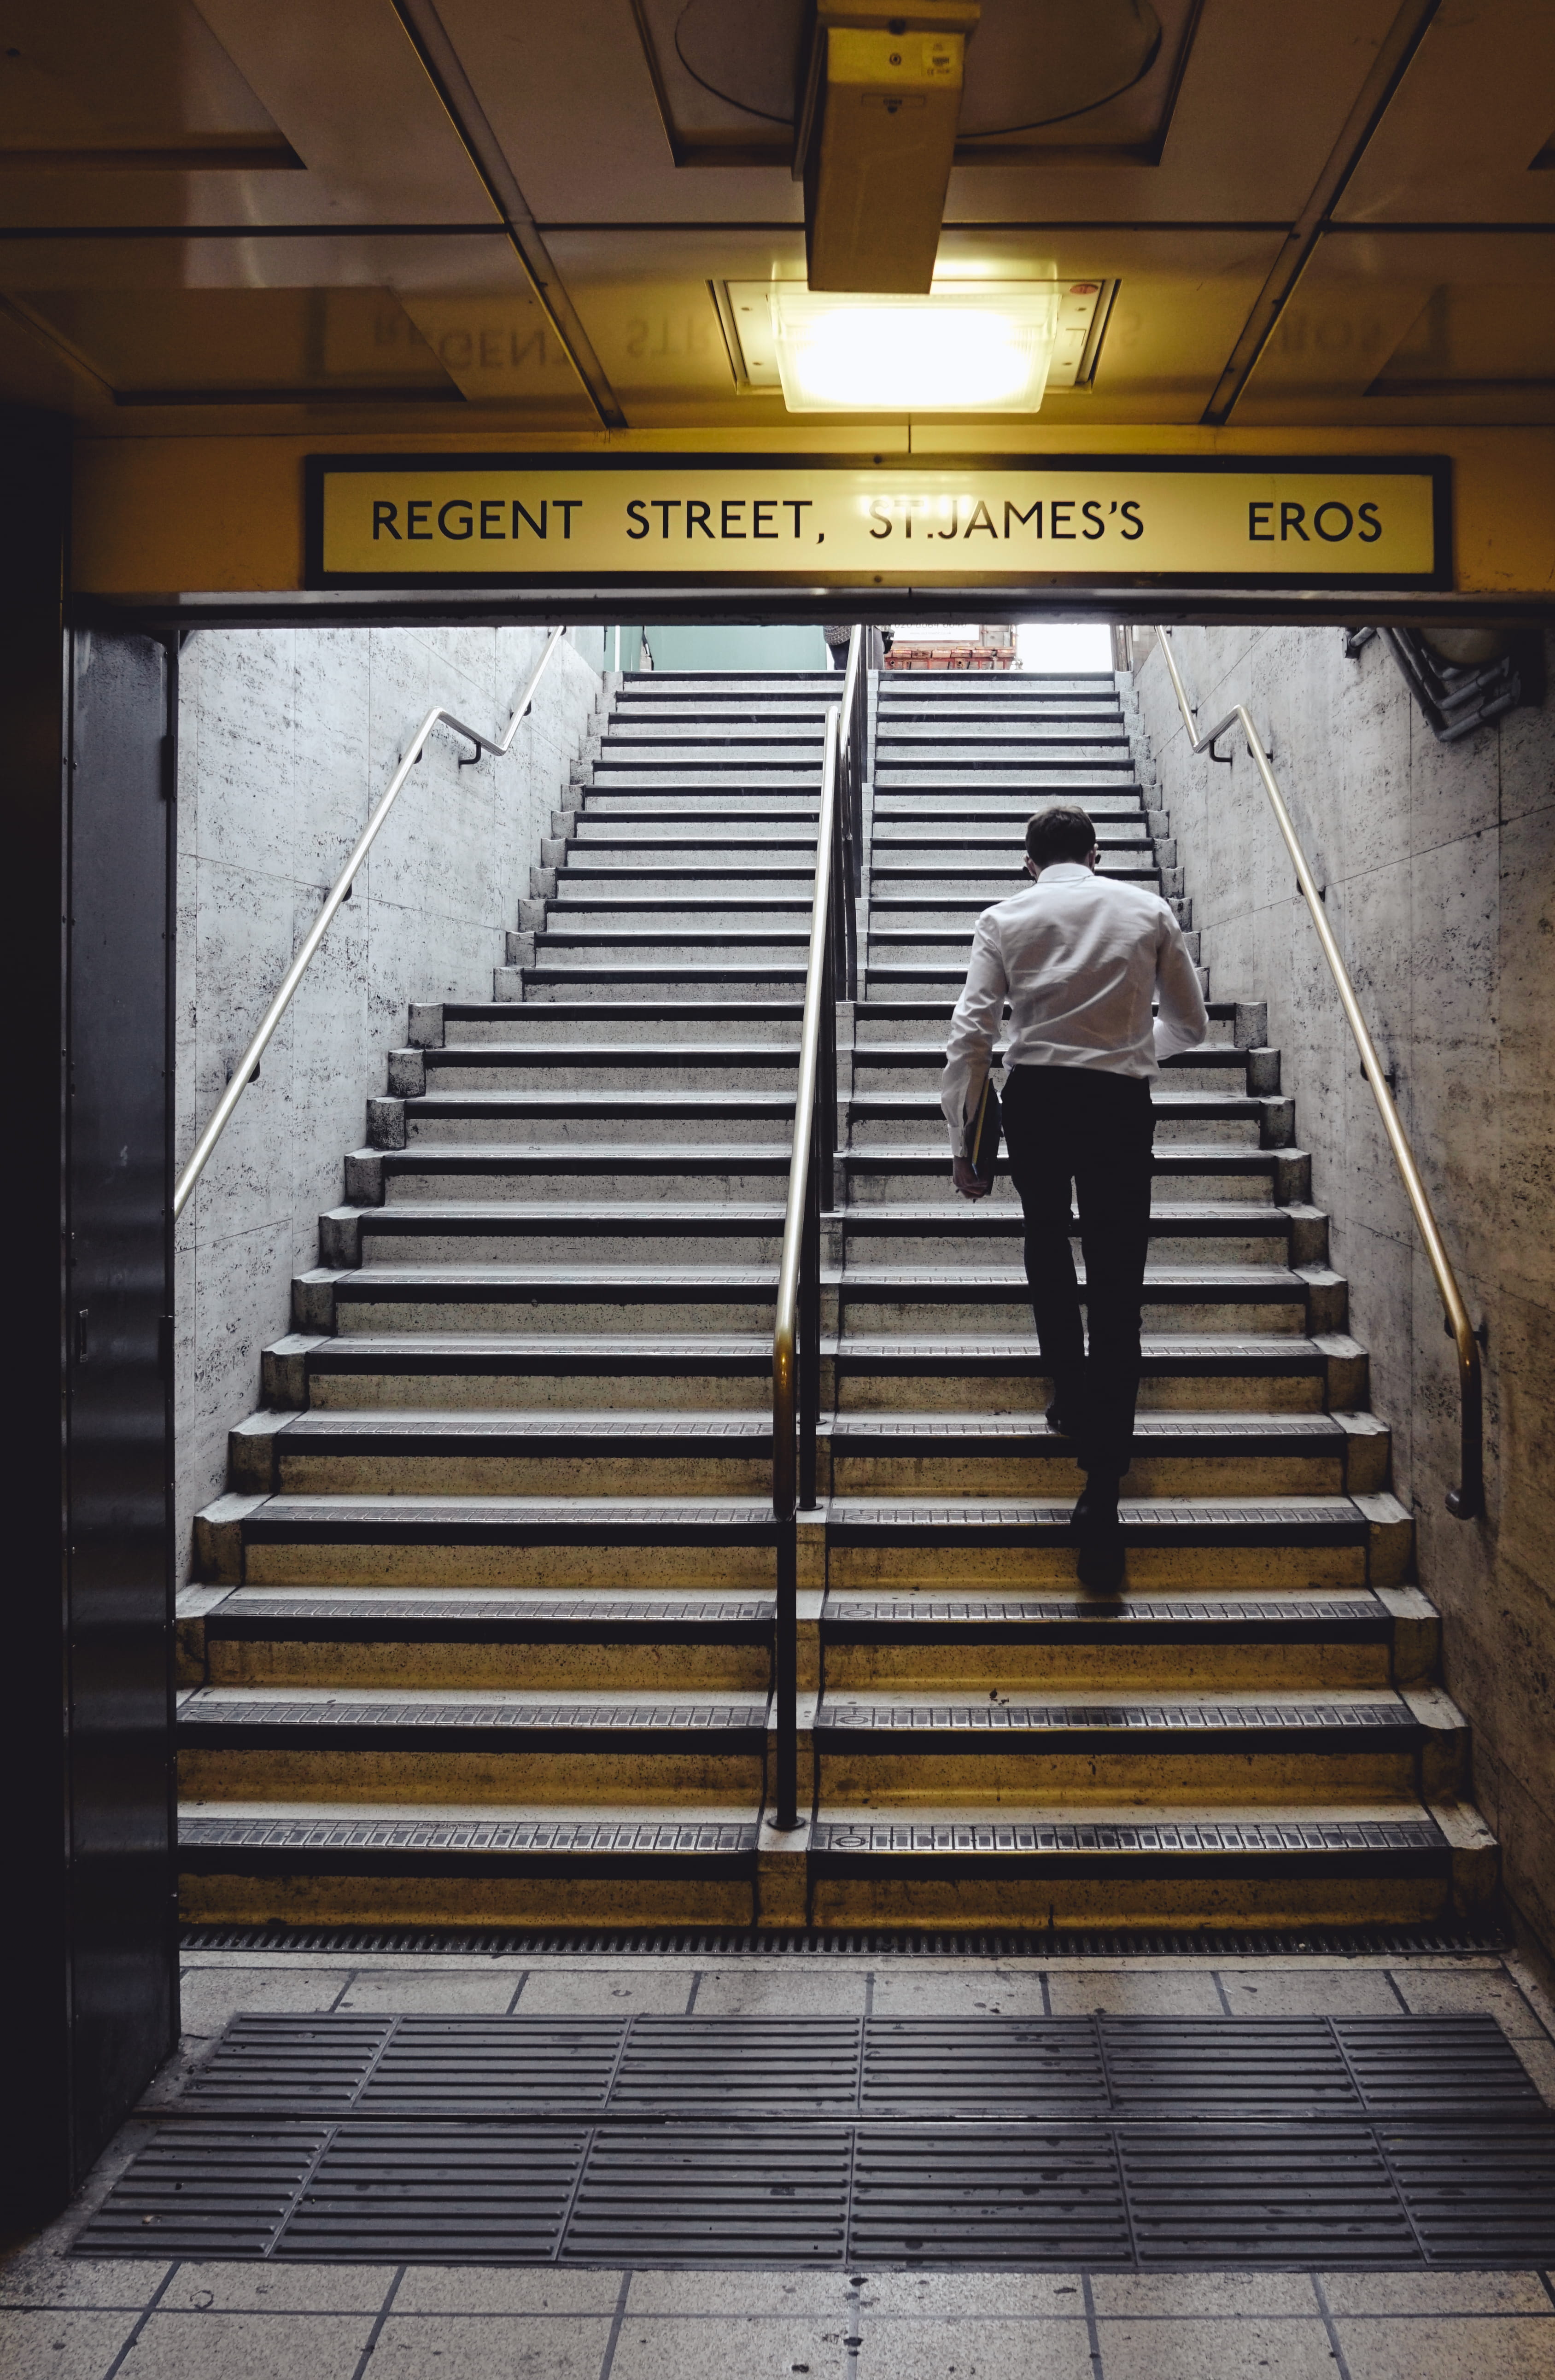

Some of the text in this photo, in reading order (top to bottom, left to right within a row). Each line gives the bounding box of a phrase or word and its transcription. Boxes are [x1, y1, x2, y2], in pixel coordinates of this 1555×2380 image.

[373, 500, 583, 540] REGENT
[626, 500, 824, 544] STREET,
[1249, 502, 1382, 542] EROS
